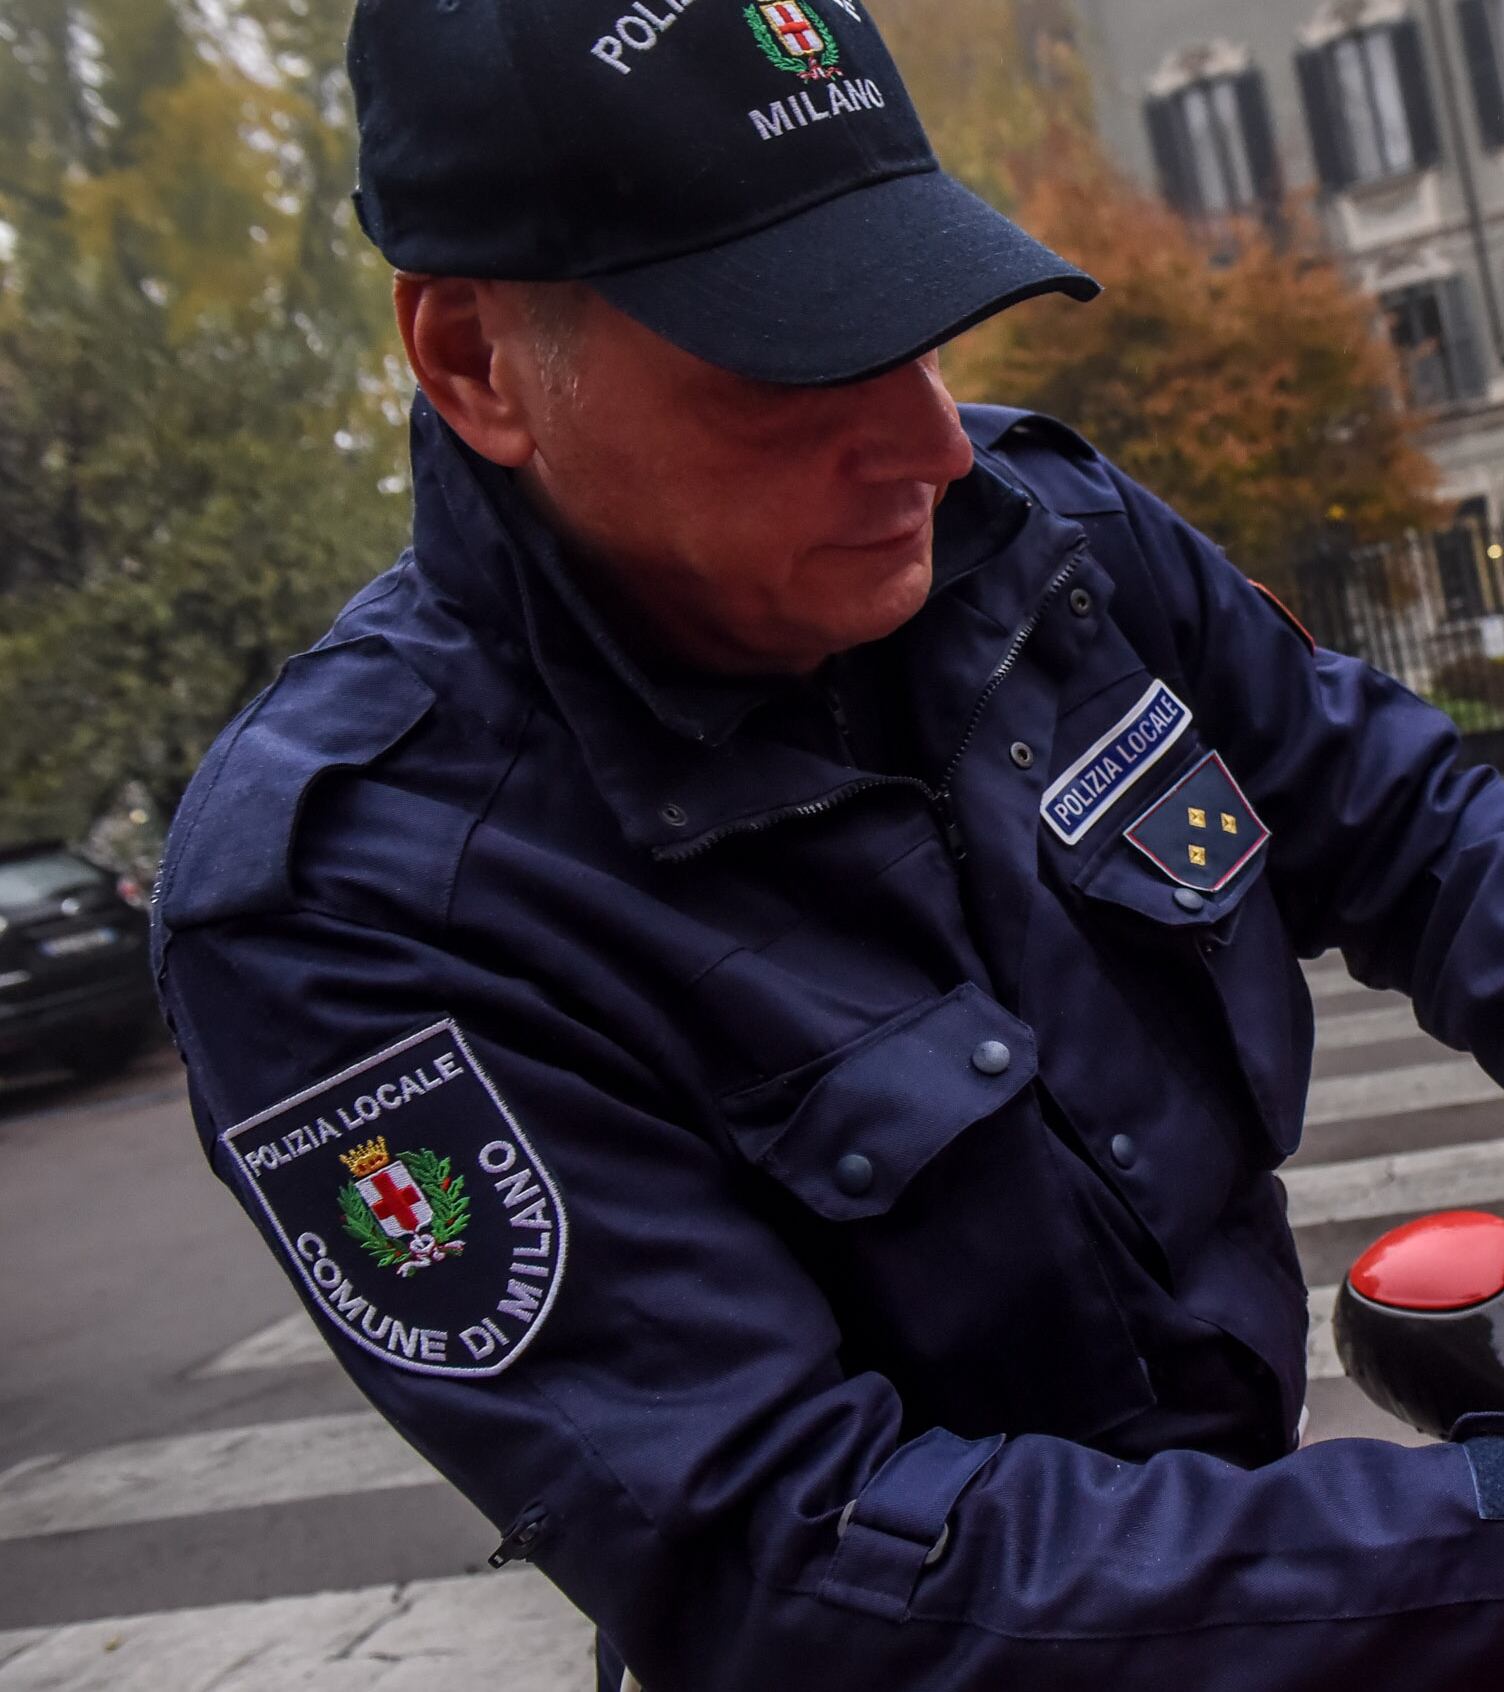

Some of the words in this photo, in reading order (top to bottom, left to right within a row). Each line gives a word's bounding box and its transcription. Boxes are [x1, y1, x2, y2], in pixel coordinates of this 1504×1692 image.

[749, 79, 885, 140] MILANO
[1053, 757, 1123, 826] POLIZIA
[1116, 695, 1178, 763] LOCALE
[245, 1117, 342, 1178] POLIZIA
[336, 1052, 464, 1130] LOCALE
[478, 1140, 552, 1323] MILANO
[297, 1232, 448, 1361] COMUNE
[459, 1317, 509, 1360] DI
